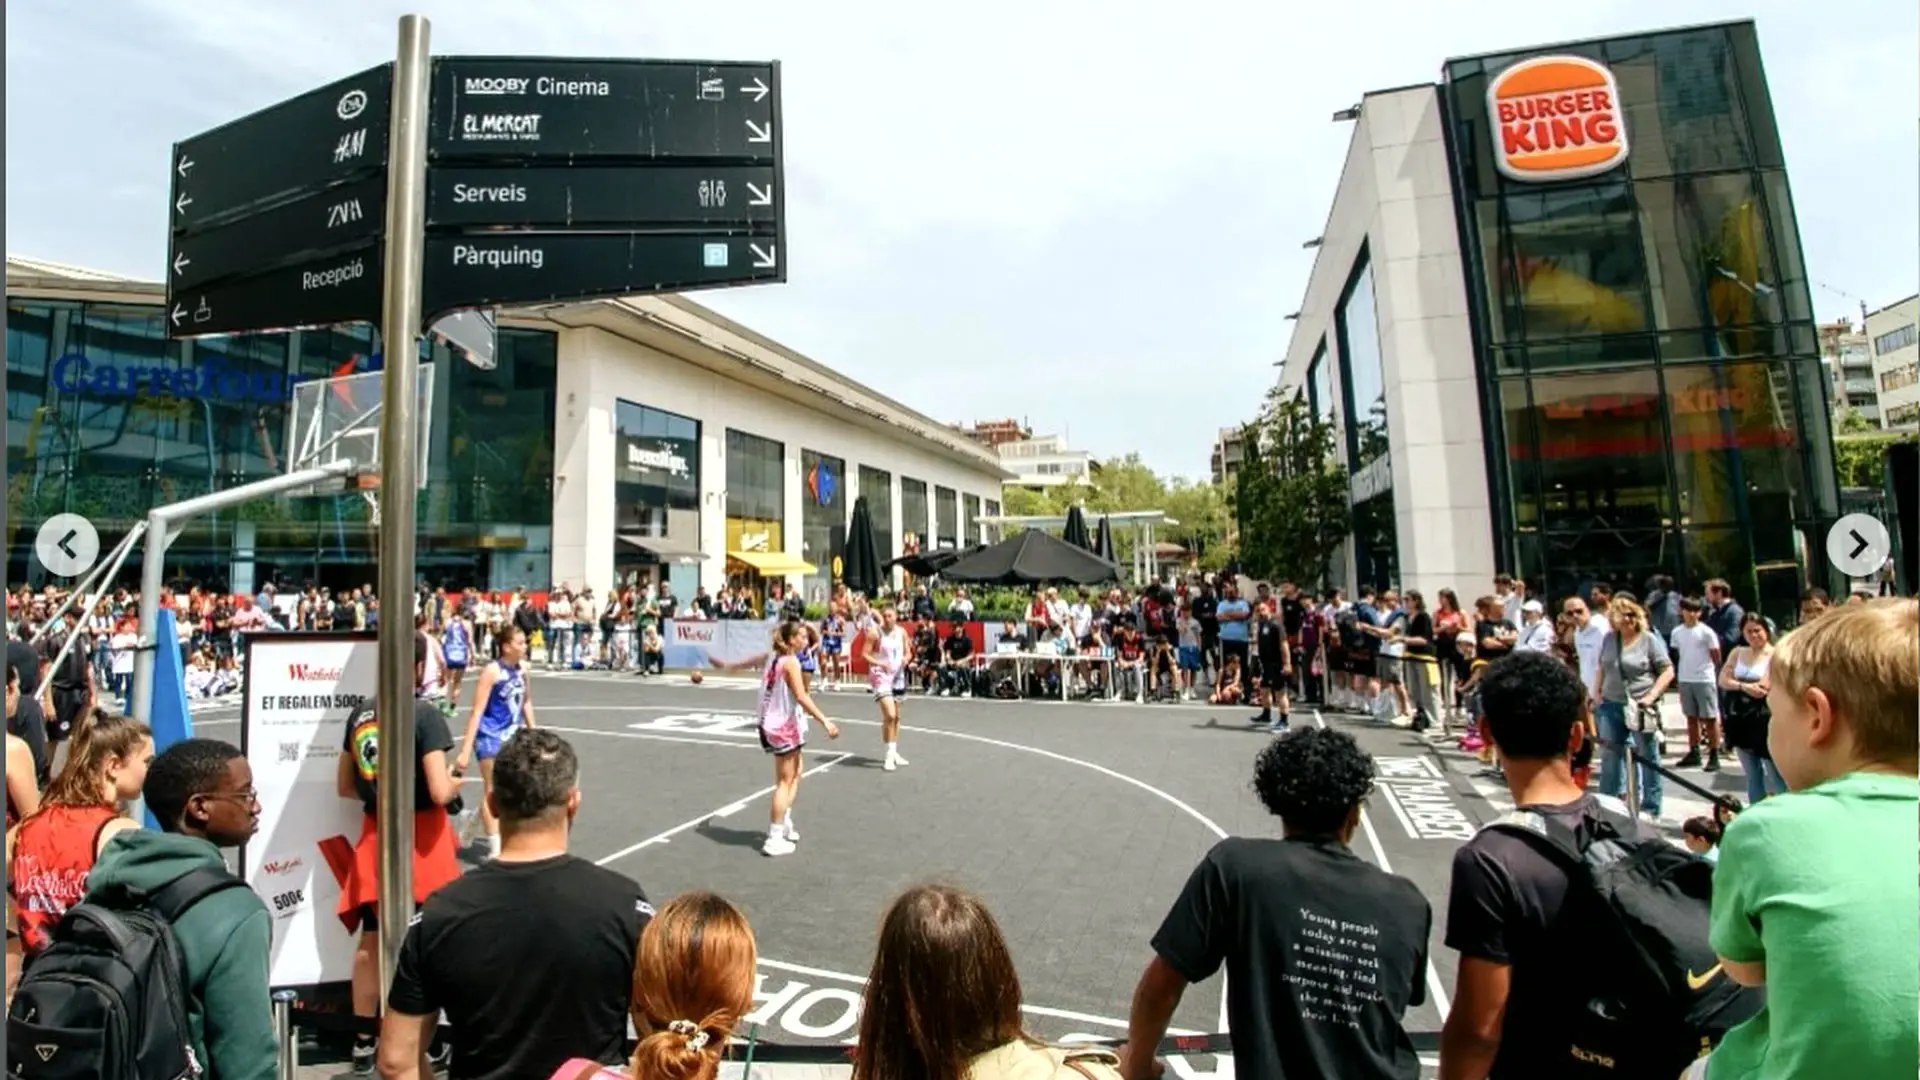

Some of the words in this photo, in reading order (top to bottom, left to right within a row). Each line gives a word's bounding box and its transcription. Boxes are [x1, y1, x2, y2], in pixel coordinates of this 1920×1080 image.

[465, 78, 530, 94] MOOBY
[536, 77, 610, 95] Cinema
[1497, 91, 1612, 122] BURGER
[333, 128, 367, 163] H&M
[1502, 113, 1617, 154] KING
[453, 184, 526, 202] Serveis
[453, 245, 543, 269] Pàrquing
[303, 257, 363, 290] Recepció
[262, 696, 275, 710] ET
[278, 695, 332, 710] REGALEM
[273, 889, 304, 910] 500€
[1300, 908, 1337, 930] Young
[1341, 922, 1379, 935] people
[1302, 929, 1336, 945] today
